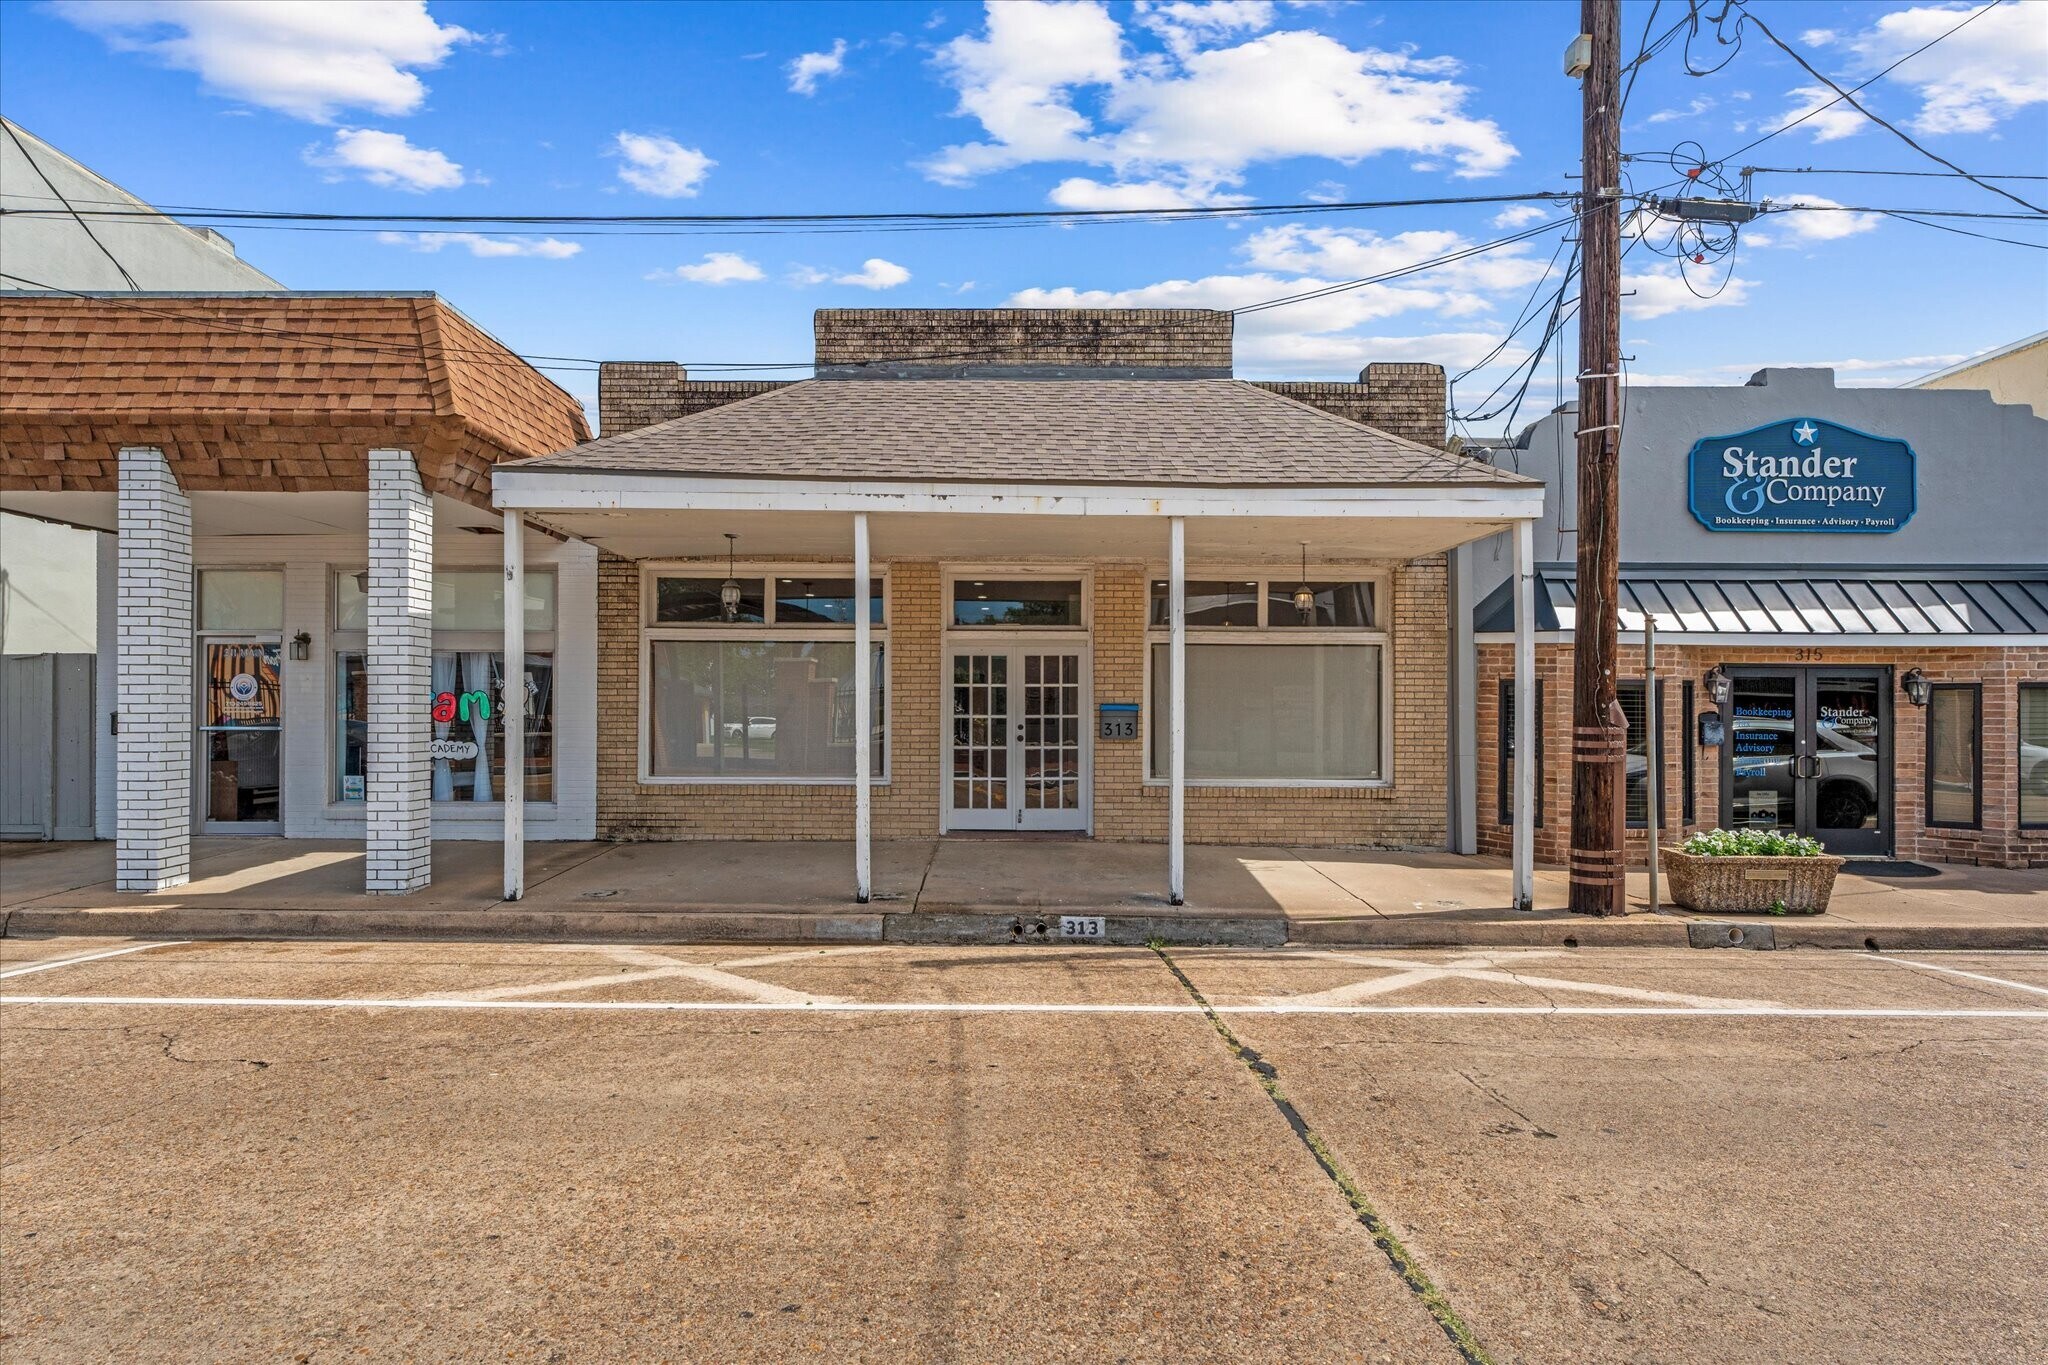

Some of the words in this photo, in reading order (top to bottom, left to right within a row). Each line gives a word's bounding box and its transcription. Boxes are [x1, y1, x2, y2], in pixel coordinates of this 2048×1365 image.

[1722, 446, 1858, 479] Stander
[1724, 474, 1768, 516] &
[1766, 478, 1886, 507] Company
[1715, 516, 1769, 527] Bookkeeping
[1775, 517, 1816, 526] Insurance
[1822, 517, 1859, 527] Advisory
[1865, 517, 1895, 527] Payroll
[1795, 648, 1823, 661] 315
[430, 690, 491, 722] am
[1735, 706, 1793, 718] Bookkeeping
[1820, 706, 1865, 717] Stander
[1834, 717, 1873, 727] Company
[1104, 722, 1133, 736] 313
[1735, 731, 1779, 740] Insurance
[430, 743, 471, 754] CADEMY
[1735, 743, 1775, 754] Advisory
[1066, 920, 1099, 936] 313
